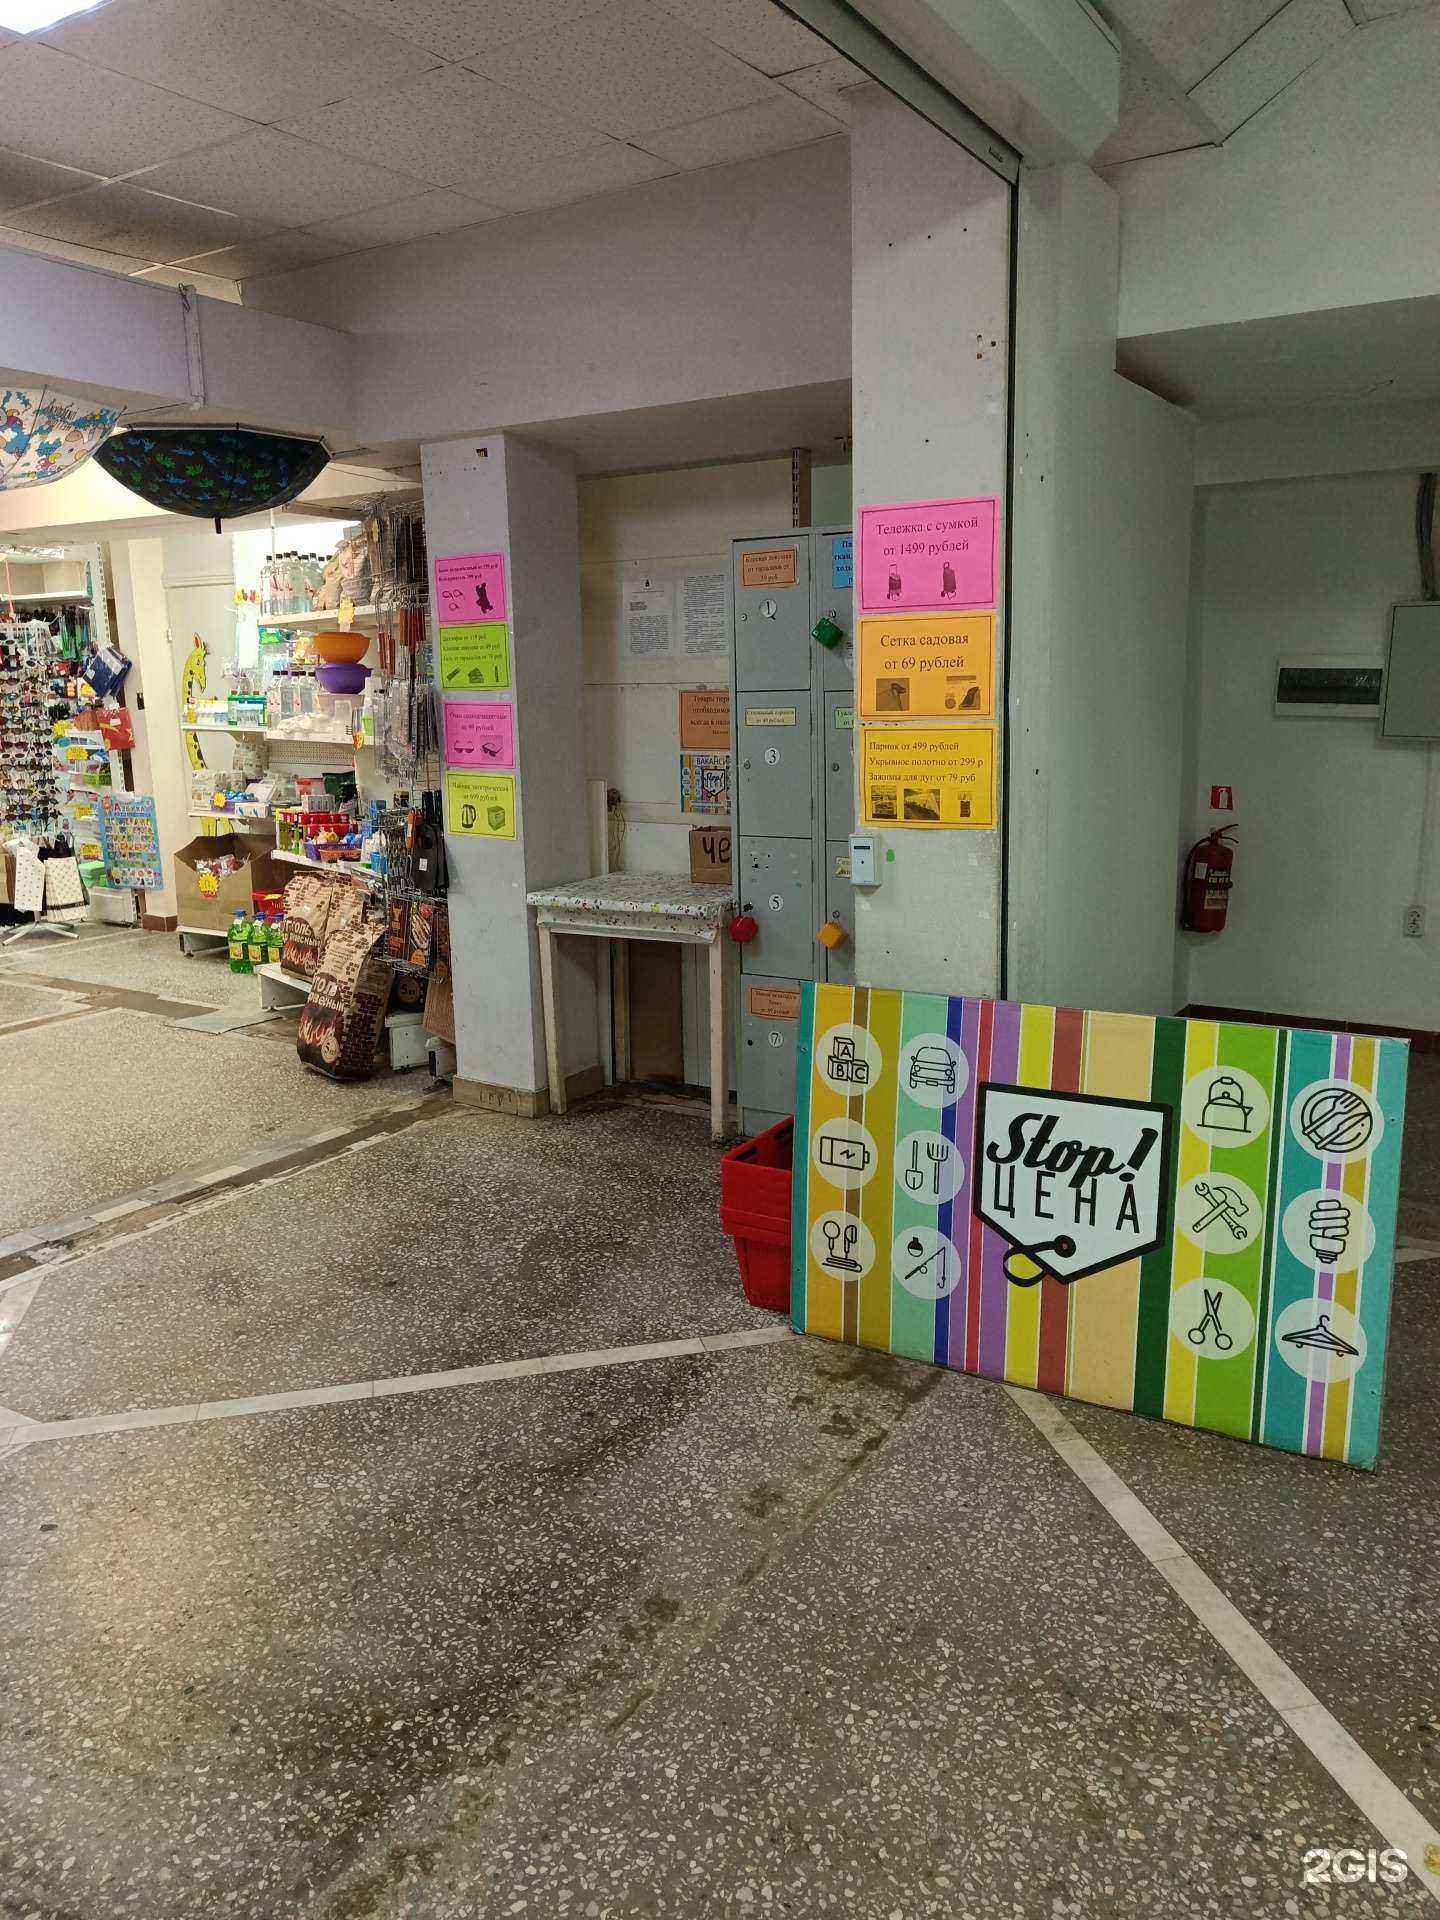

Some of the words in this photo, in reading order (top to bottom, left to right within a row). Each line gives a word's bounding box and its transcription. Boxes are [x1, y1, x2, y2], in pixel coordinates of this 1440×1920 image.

[876, 522, 923, 535] Тележка
[926, 523, 933, 532] с
[935, 516, 978, 533] сумкой
[883, 547, 895, 556] от
[901, 542, 925, 555] 1499
[928, 539, 969, 556] рублей
[880, 634, 916, 647] Сетка
[919, 634, 969, 647] садовая
[884, 660, 898, 670] от
[901, 656, 916, 669] 69
[919, 656, 964, 672] рублей
[869, 742, 899, 752] Парник
[912, 742, 927, 750] 499
[929, 742, 959, 752] рублей
[767, 749, 777, 764] 3
[960, 758, 975, 766] 299
[978, 759, 984, 768] р
[948, 773, 957, 781] 79
[960, 773, 976, 783] руб
[772, 897, 781, 910] 5
[771, 1032, 779, 1046] 7
[840, 1044, 852, 1058] A
[986, 1112, 1159, 1189] Stop!
[993, 1162, 1140, 1234] ЦЕНА
